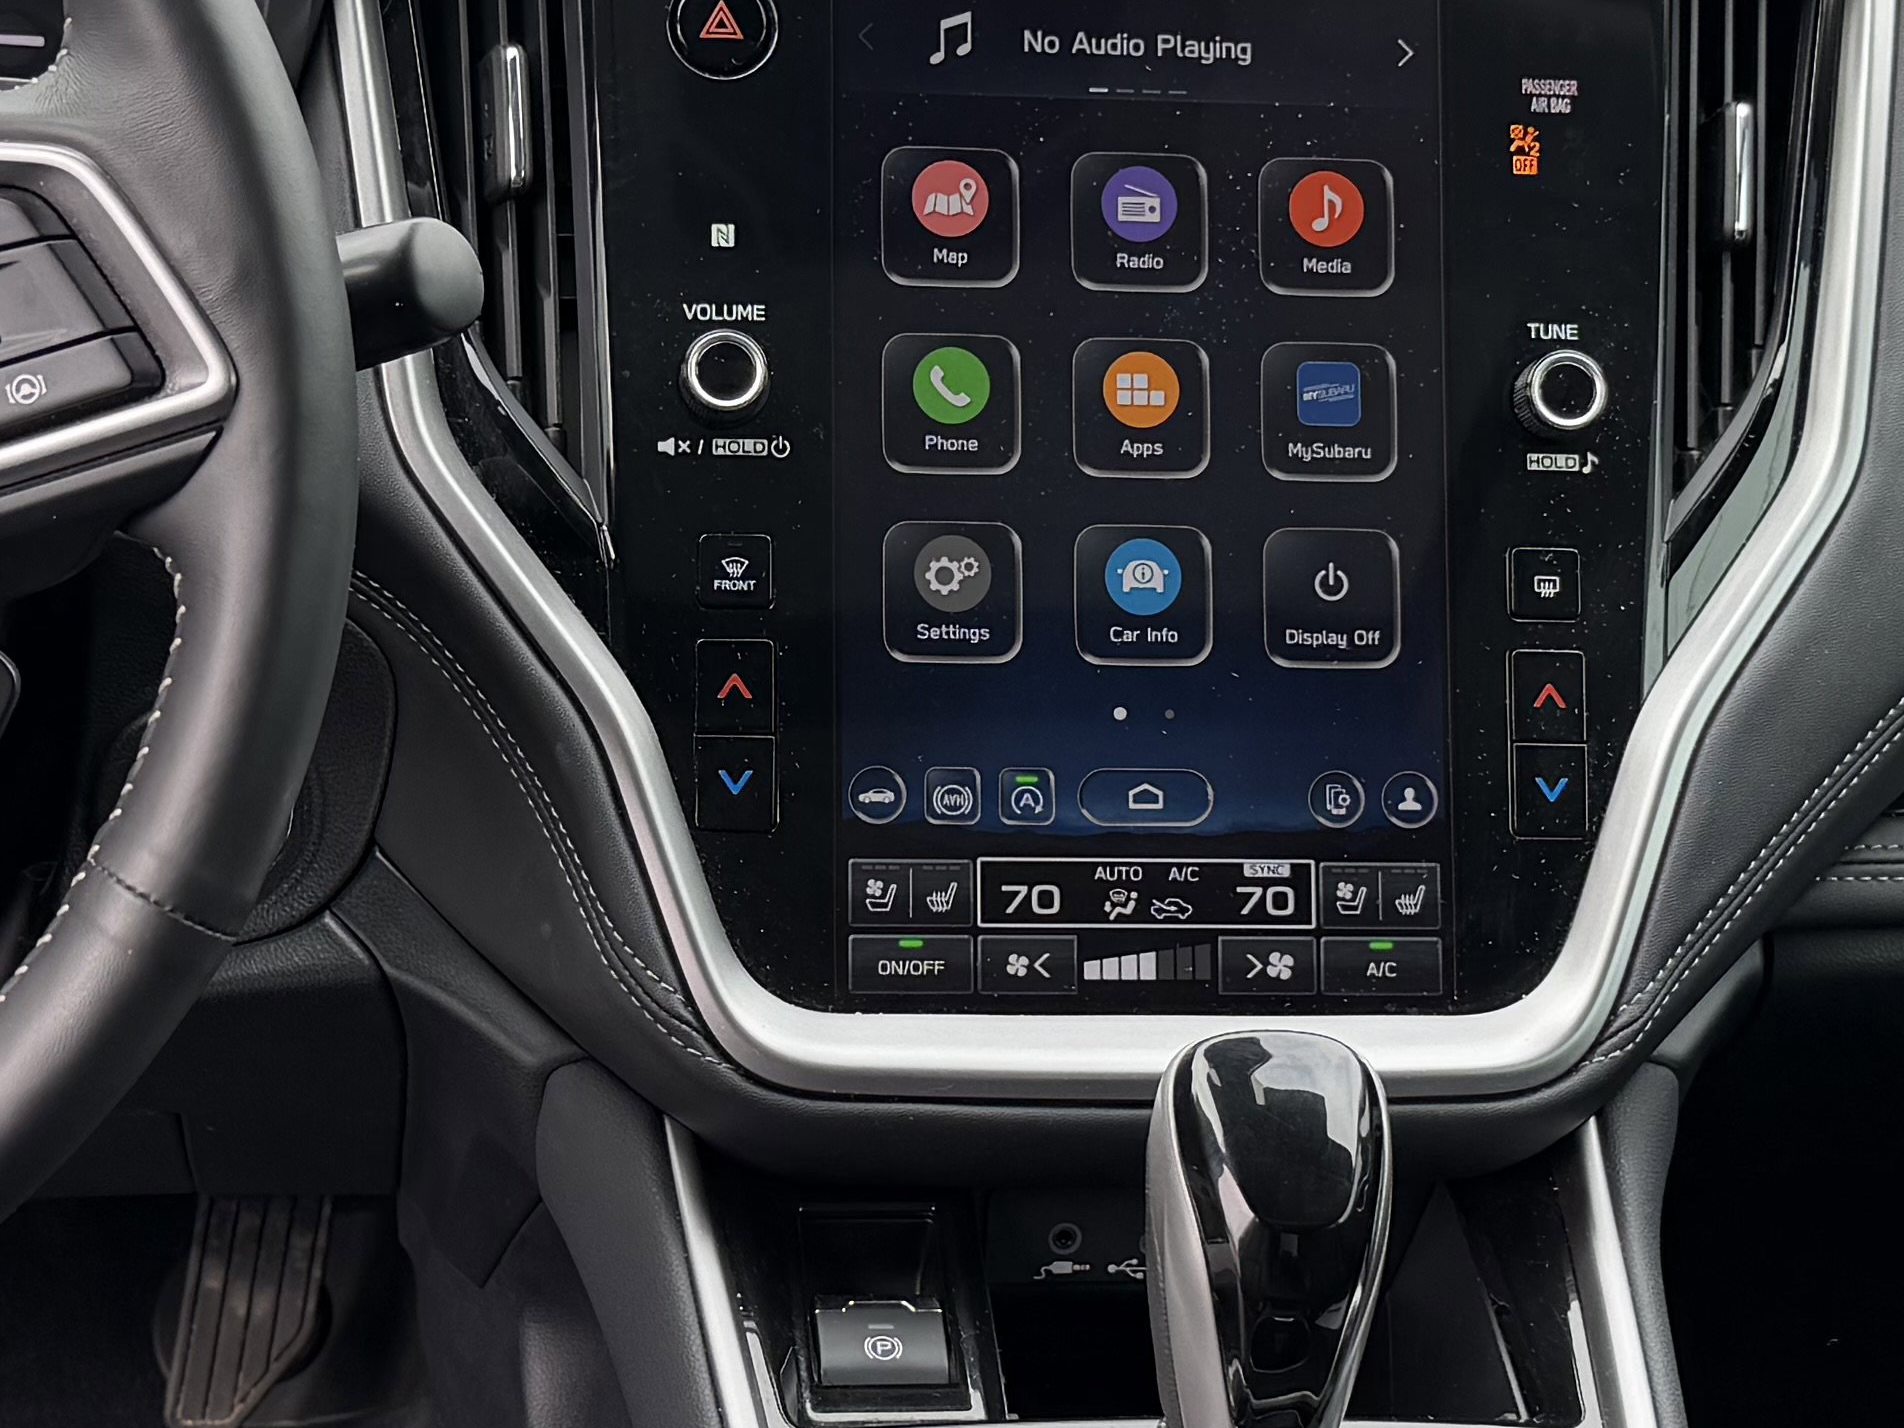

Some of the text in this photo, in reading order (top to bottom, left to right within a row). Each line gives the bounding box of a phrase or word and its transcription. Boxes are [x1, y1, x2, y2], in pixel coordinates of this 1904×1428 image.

[1023, 30, 1252, 65] No Audio Playing
[1521, 78, 1578, 96] PASSENGER
[1550, 97, 1571, 114] BAG
[1514, 158, 1536, 172] OFF
[932, 248, 968, 267] Map
[1115, 253, 1164, 271] Radio
[1302, 258, 1352, 275] Media
[683, 303, 766, 322] VOLUME
[1527, 323, 1579, 341] TUNE
[713, 439, 767, 456] HOLD
[924, 435, 978, 452] Phone
[1120, 439, 1164, 459] Apps
[1288, 442, 1372, 461] MySubaru
[1528, 454, 1578, 471] HOLD
[713, 579, 757, 591] FRONT
[915, 622, 991, 642] Settings
[1109, 626, 1179, 644] Car Info
[1285, 629, 1381, 648] Display Off
[1094, 866, 1200, 883] AUTO A/C
[1247, 863, 1288, 877] SYNC
[1000, 885, 1061, 916] 70
[1235, 886, 1296, 917] 70
[877, 959, 945, 976] ON/OFF
[1366, 961, 1397, 978] A/C
